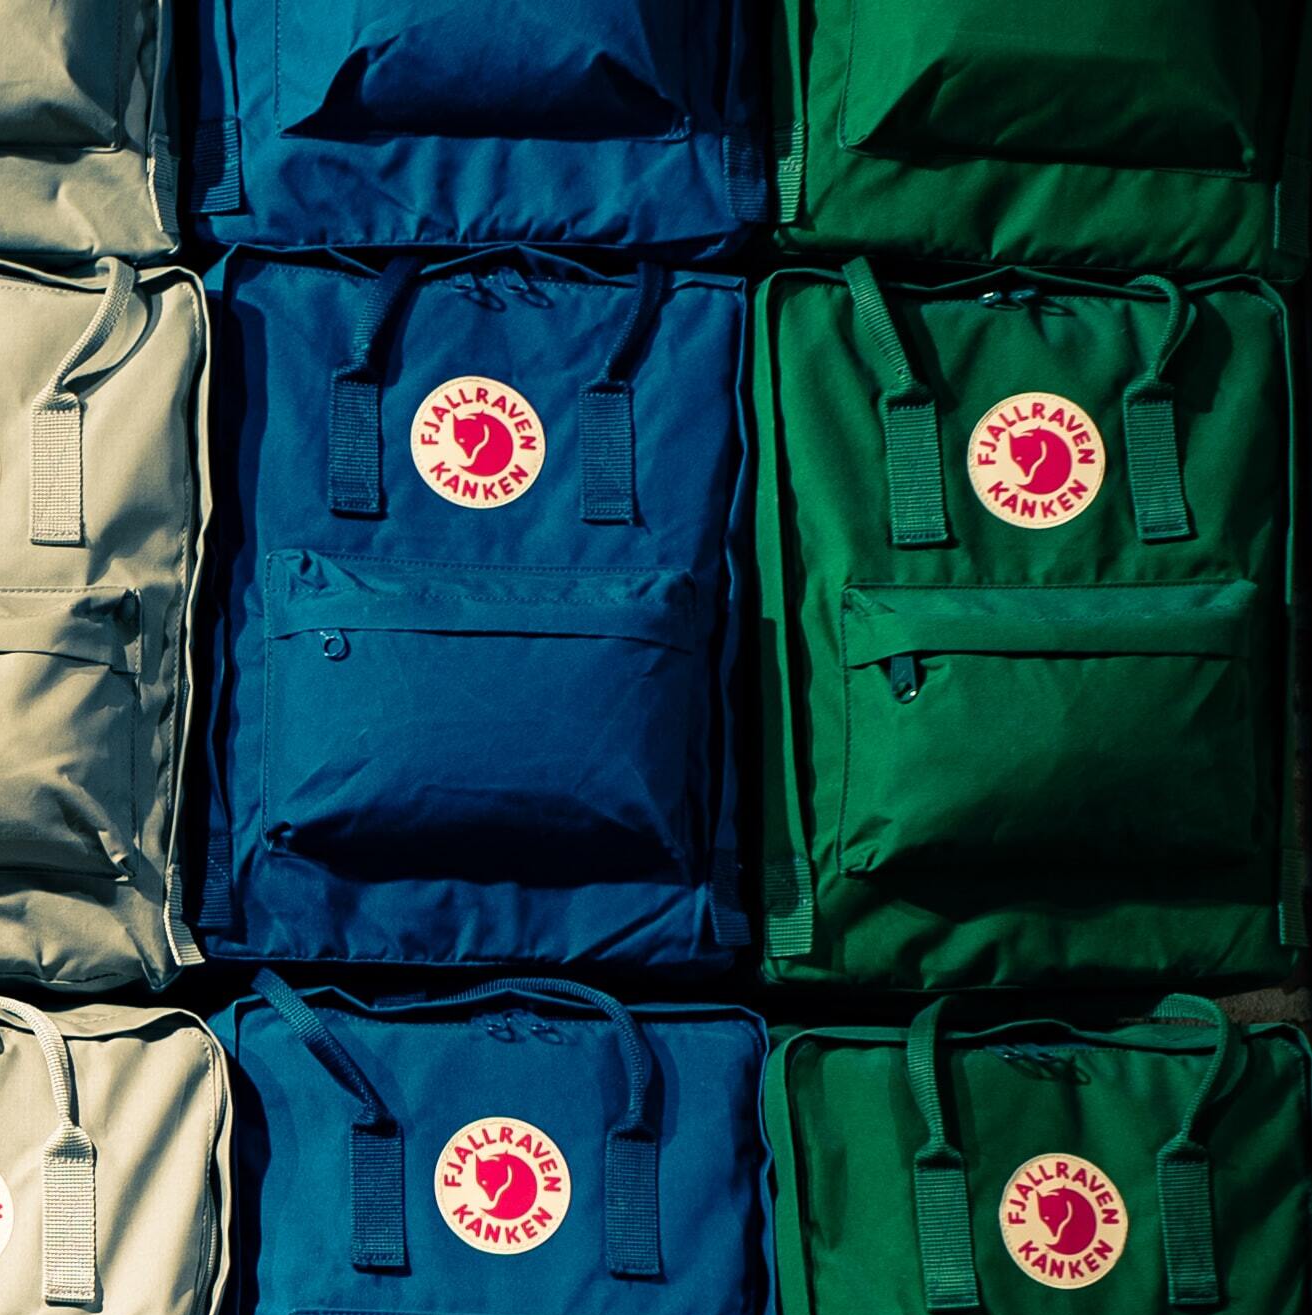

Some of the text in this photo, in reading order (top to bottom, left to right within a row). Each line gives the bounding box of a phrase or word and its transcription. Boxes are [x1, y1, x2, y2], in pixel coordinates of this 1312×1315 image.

[421, 387, 537, 450] FJALLRAVEN
[977, 402, 1095, 465] FJALLRAVEN
[444, 1126, 561, 1192] FJALLRAVEN
[1008, 1162, 1119, 1224] FJALLRAVEN
